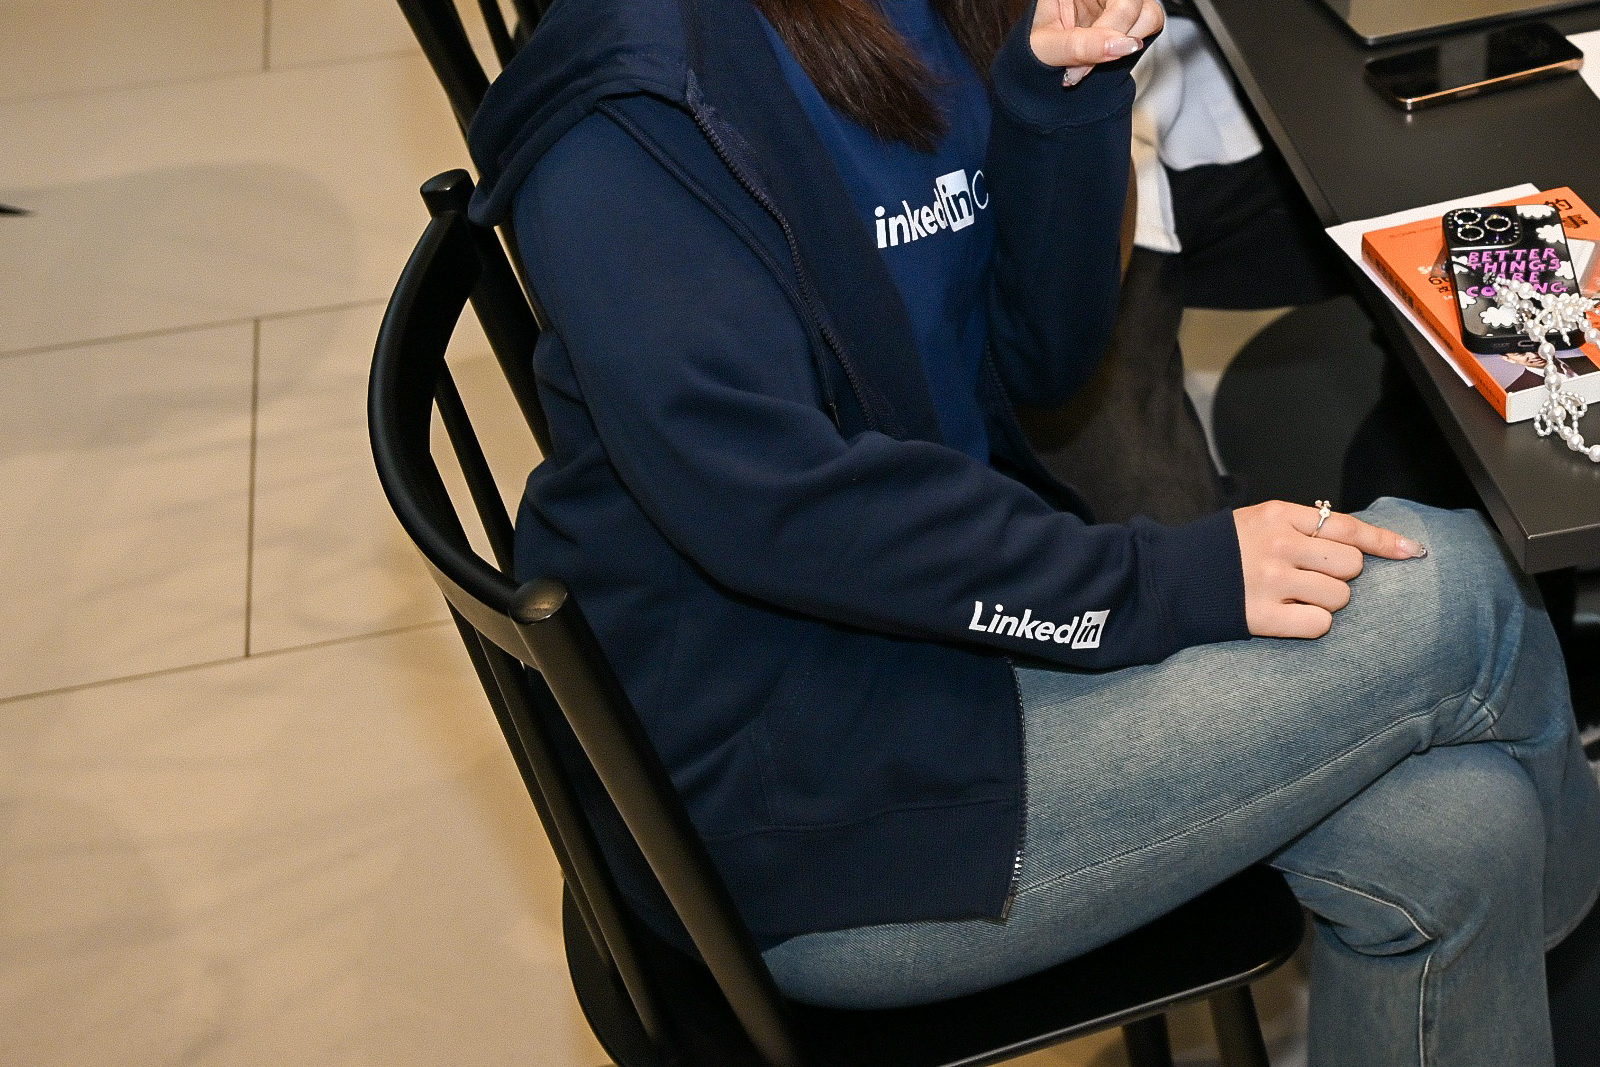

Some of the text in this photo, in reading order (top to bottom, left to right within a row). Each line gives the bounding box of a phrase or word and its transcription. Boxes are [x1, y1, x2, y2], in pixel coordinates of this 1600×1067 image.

[1467, 247, 1558, 264] BETTER
[1466, 258, 1561, 273] THINGS
[1465, 281, 1569, 298] CONG
